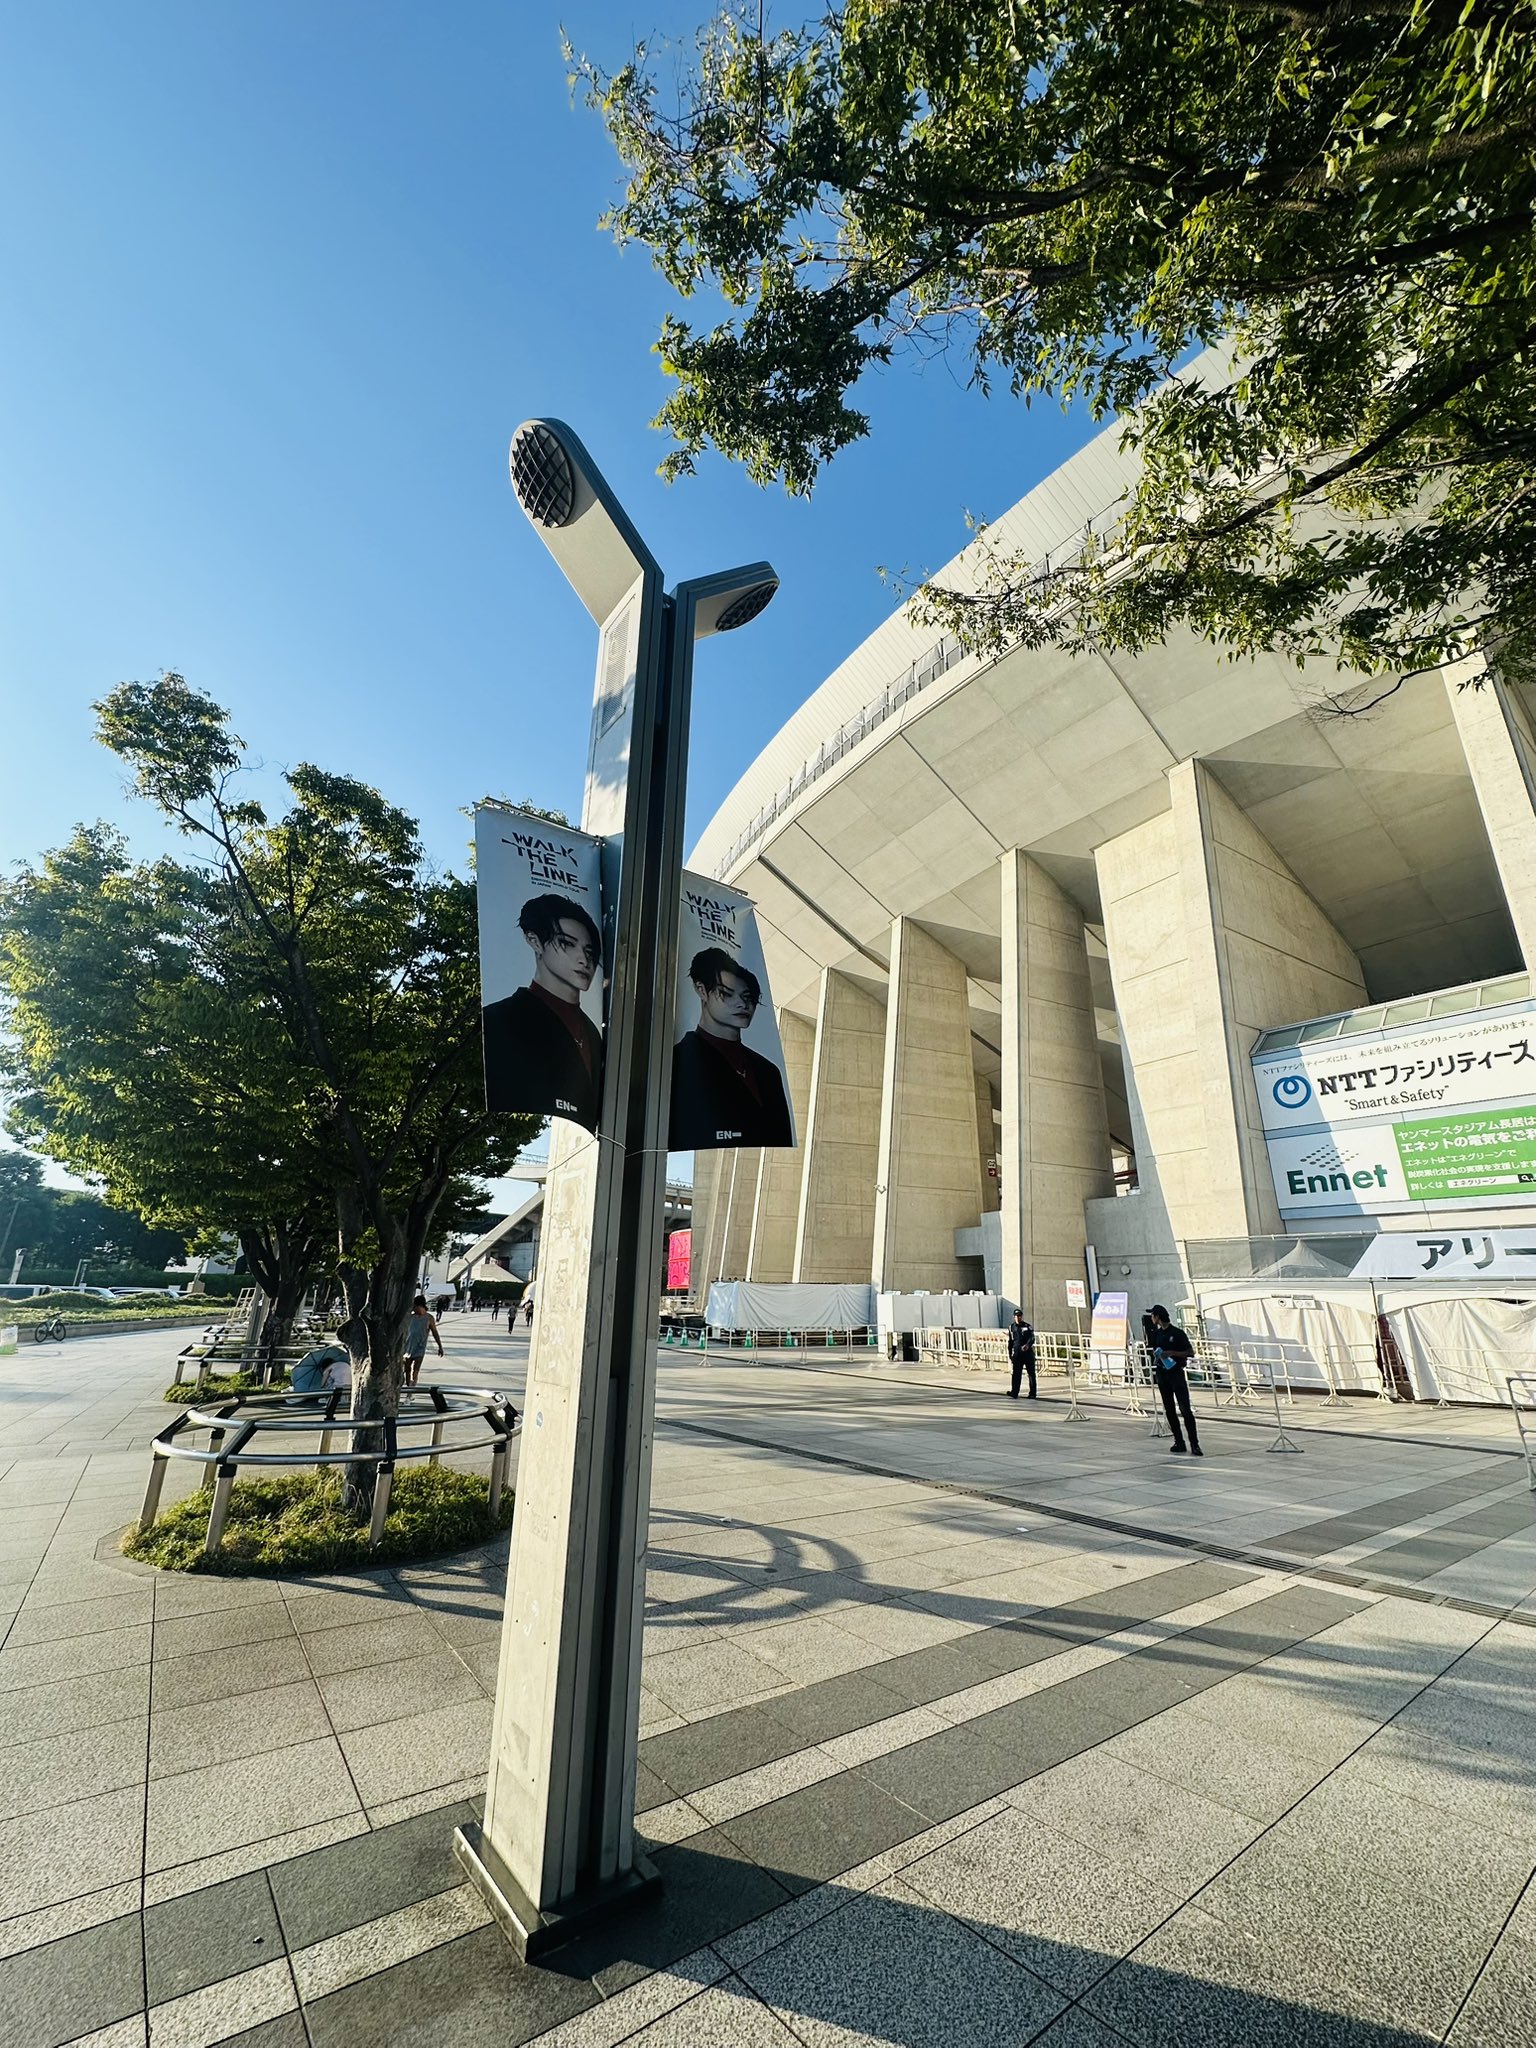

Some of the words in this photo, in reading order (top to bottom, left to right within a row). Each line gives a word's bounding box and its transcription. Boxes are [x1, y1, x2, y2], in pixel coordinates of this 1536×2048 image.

[502, 838, 557, 867] THE
[512, 832, 578, 867] WALK
[530, 861, 588, 891] LINE
[681, 898, 723, 923] THE
[686, 890, 736, 925] WALK
[699, 918, 742, 949] LINE
[1317, 1039, 1536, 1096] NTTファシリティーズ
[1286, 1164, 1388, 1195] Ennet
[1416, 1236, 1536, 1271] アリー
